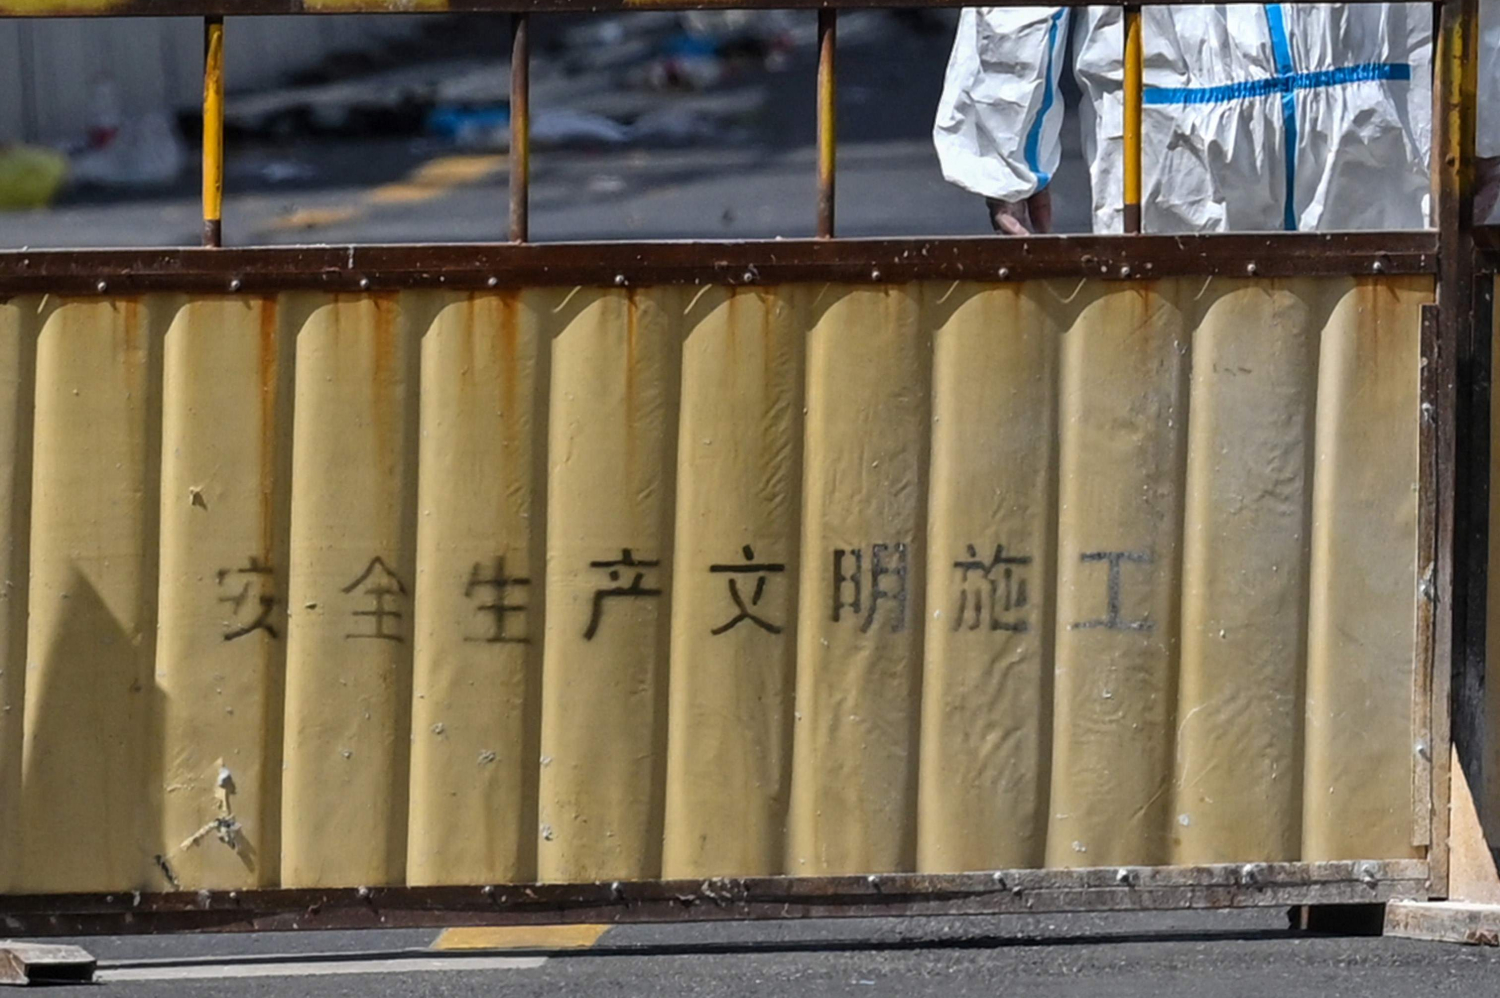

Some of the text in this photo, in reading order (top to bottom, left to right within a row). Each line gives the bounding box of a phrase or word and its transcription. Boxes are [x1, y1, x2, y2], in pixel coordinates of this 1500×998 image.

[217, 543, 1156, 643] 安全生产文明施工
